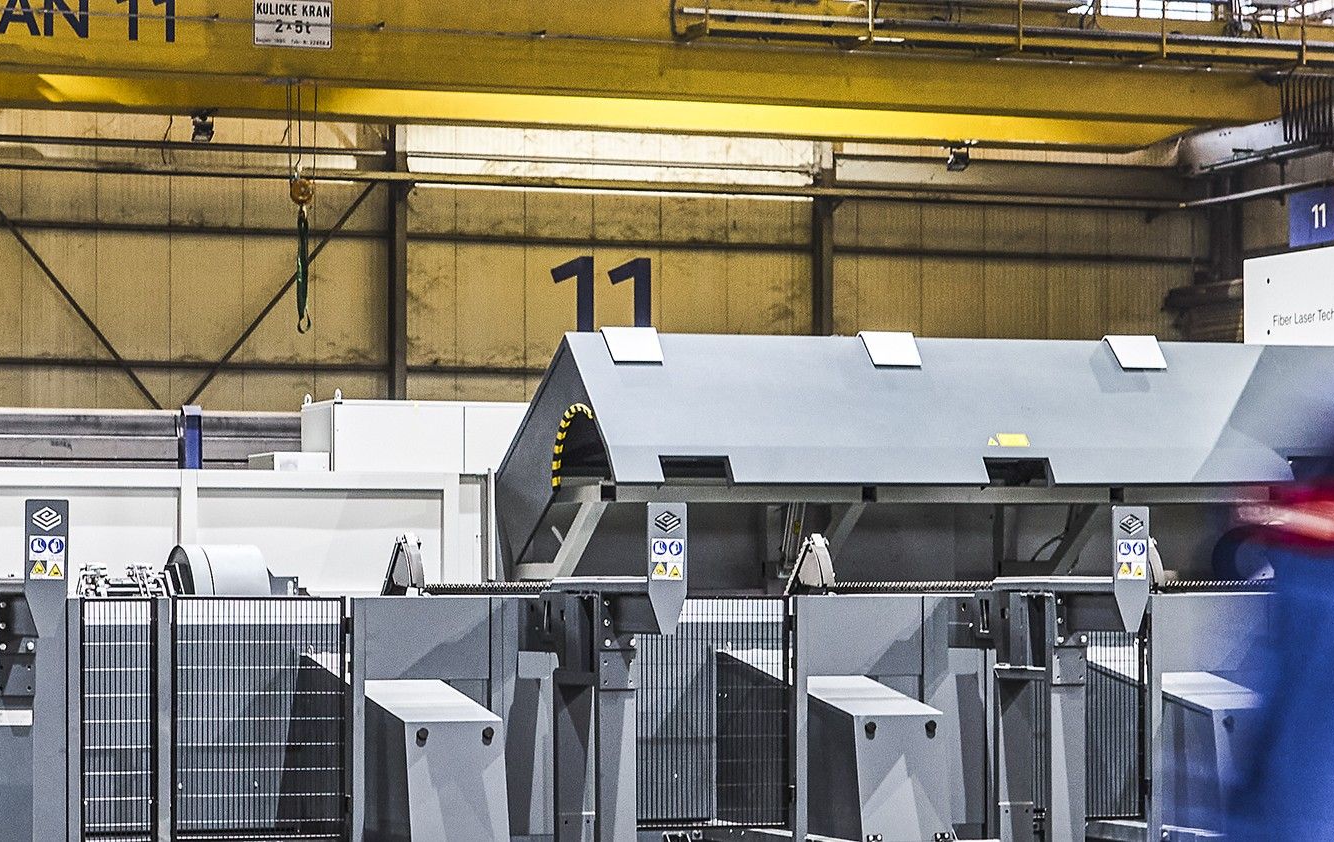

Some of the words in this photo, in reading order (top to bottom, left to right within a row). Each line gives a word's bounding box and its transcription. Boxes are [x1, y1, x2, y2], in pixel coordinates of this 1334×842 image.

[116, 0, 176, 43] 11
[256, 2, 297, 16] KULICKE
[302, 5, 330, 17] KRAN
[1311, 203, 1326, 229] 11
[550, 255, 652, 333] 11
[1273, 314, 1292, 326] Fiber
[1294, 312, 1316, 324] Laser
